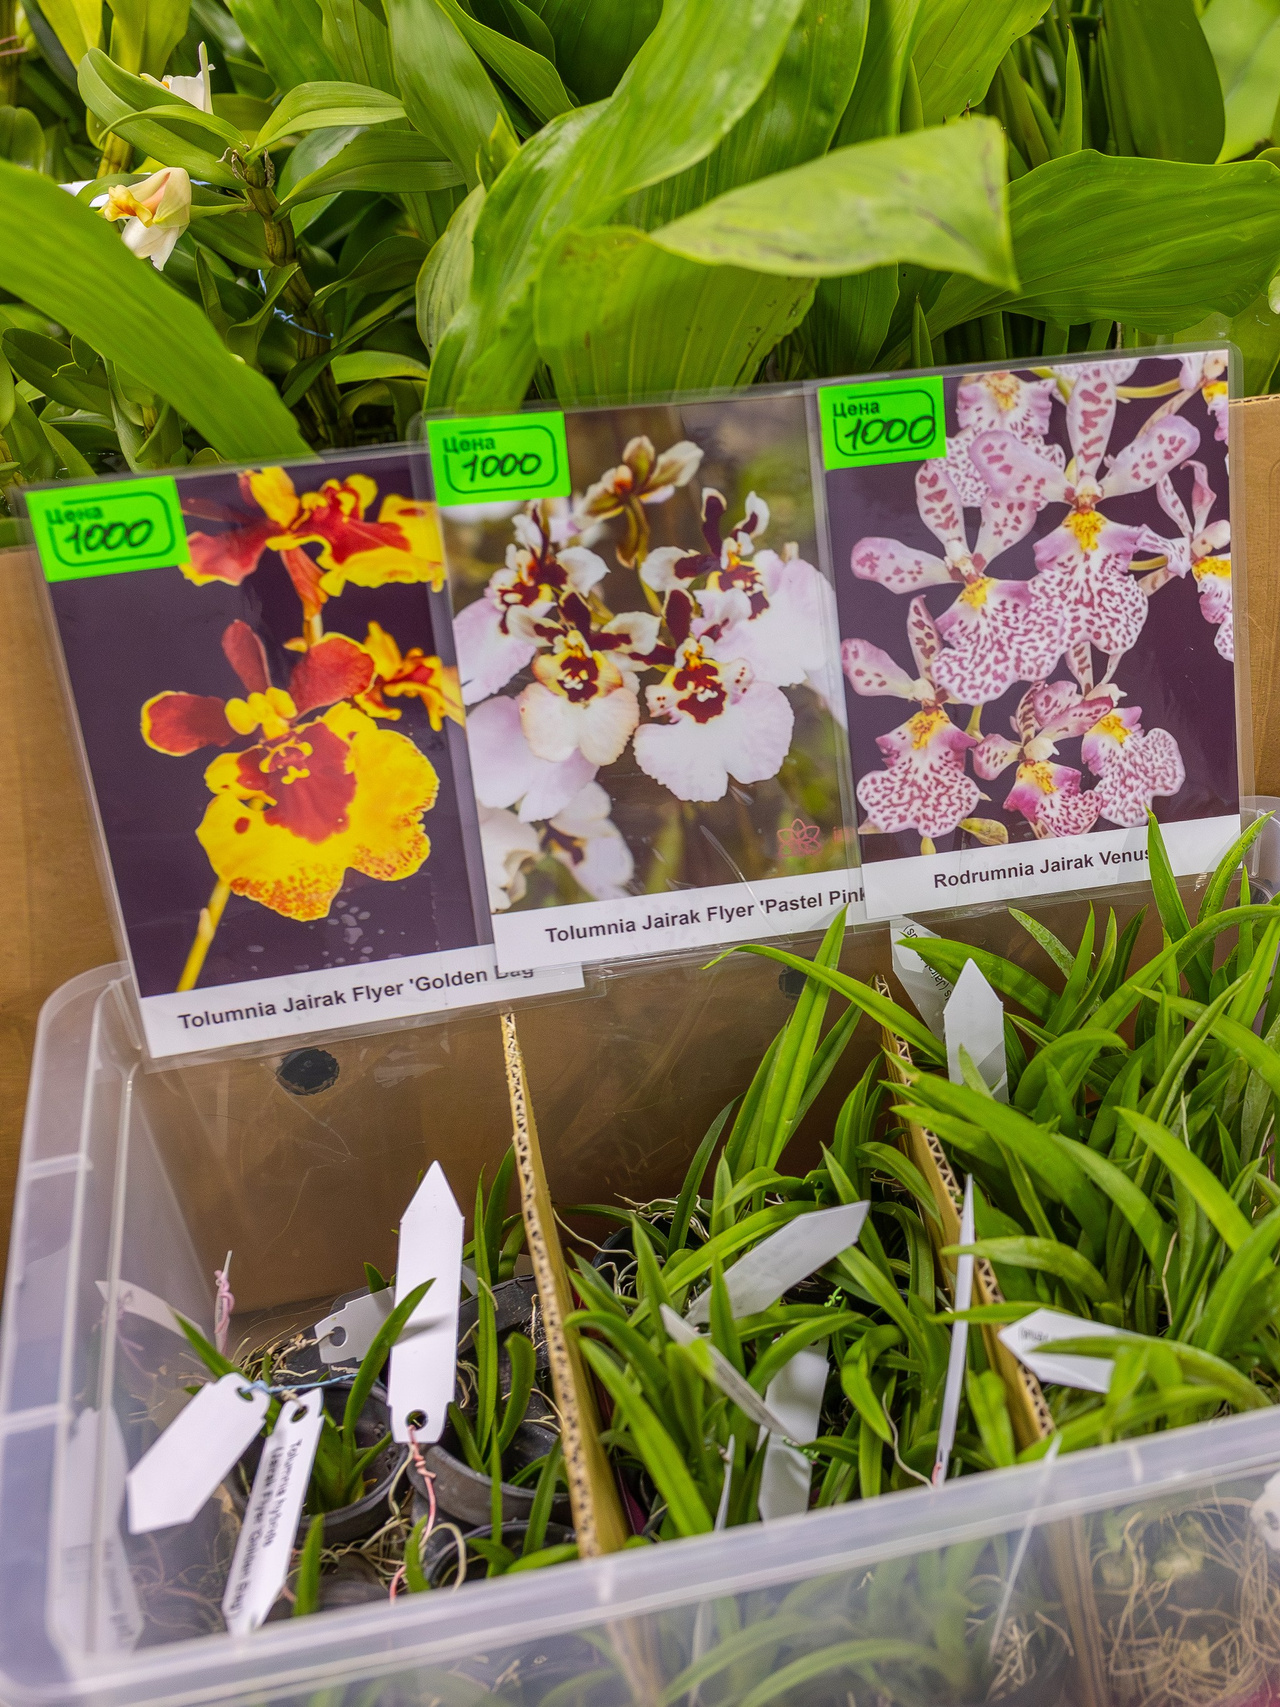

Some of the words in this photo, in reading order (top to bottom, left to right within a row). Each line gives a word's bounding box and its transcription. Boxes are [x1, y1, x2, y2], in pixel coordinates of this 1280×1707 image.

[833, 401, 880, 418] Цена
[443, 437, 495, 454] Цена
[845, 416, 935, 450] 1000
[462, 453, 541, 482] 1000
[64, 519, 153, 554] 1000
[934, 862, 1034, 888] Rodrumnia
[1040, 854, 1094, 874] Jairak
[545, 920, 636, 942] Tolumnia
[642, 909, 700, 930] Jairak
[707, 905, 754, 924] Flyer
[760, 892, 822, 914] 'Pastel
[178, 1002, 276, 1029] Tolumnia
[283, 990, 346, 1014] Jairak
[353, 982, 404, 1004] Flyer
[409, 968, 488, 992] 'Golden
